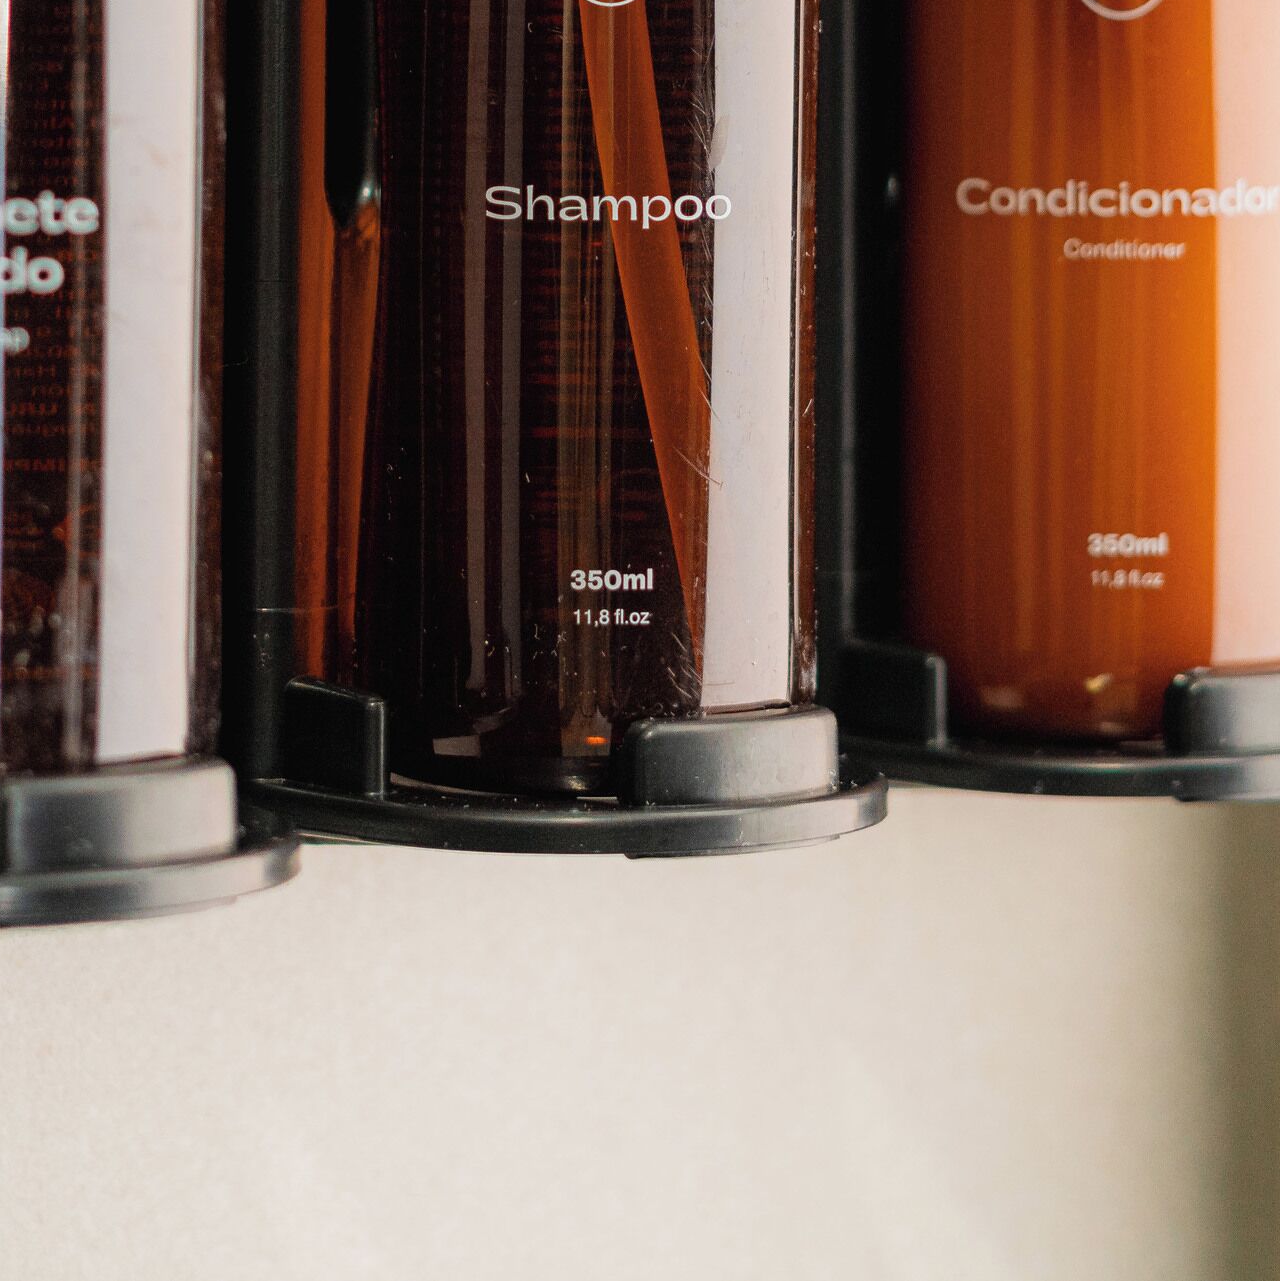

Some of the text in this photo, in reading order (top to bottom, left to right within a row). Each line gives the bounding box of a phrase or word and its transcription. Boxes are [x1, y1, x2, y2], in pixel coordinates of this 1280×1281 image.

[485, 184, 732, 230] Shampoo
[956, 178, 1280, 217] Condicionador
[1064, 238, 1186, 260] Conditioner
[1087, 531, 1169, 557] 350ml
[570, 567, 654, 591] 350ml
[573, 608, 651, 628] 11,8 fl.oz
